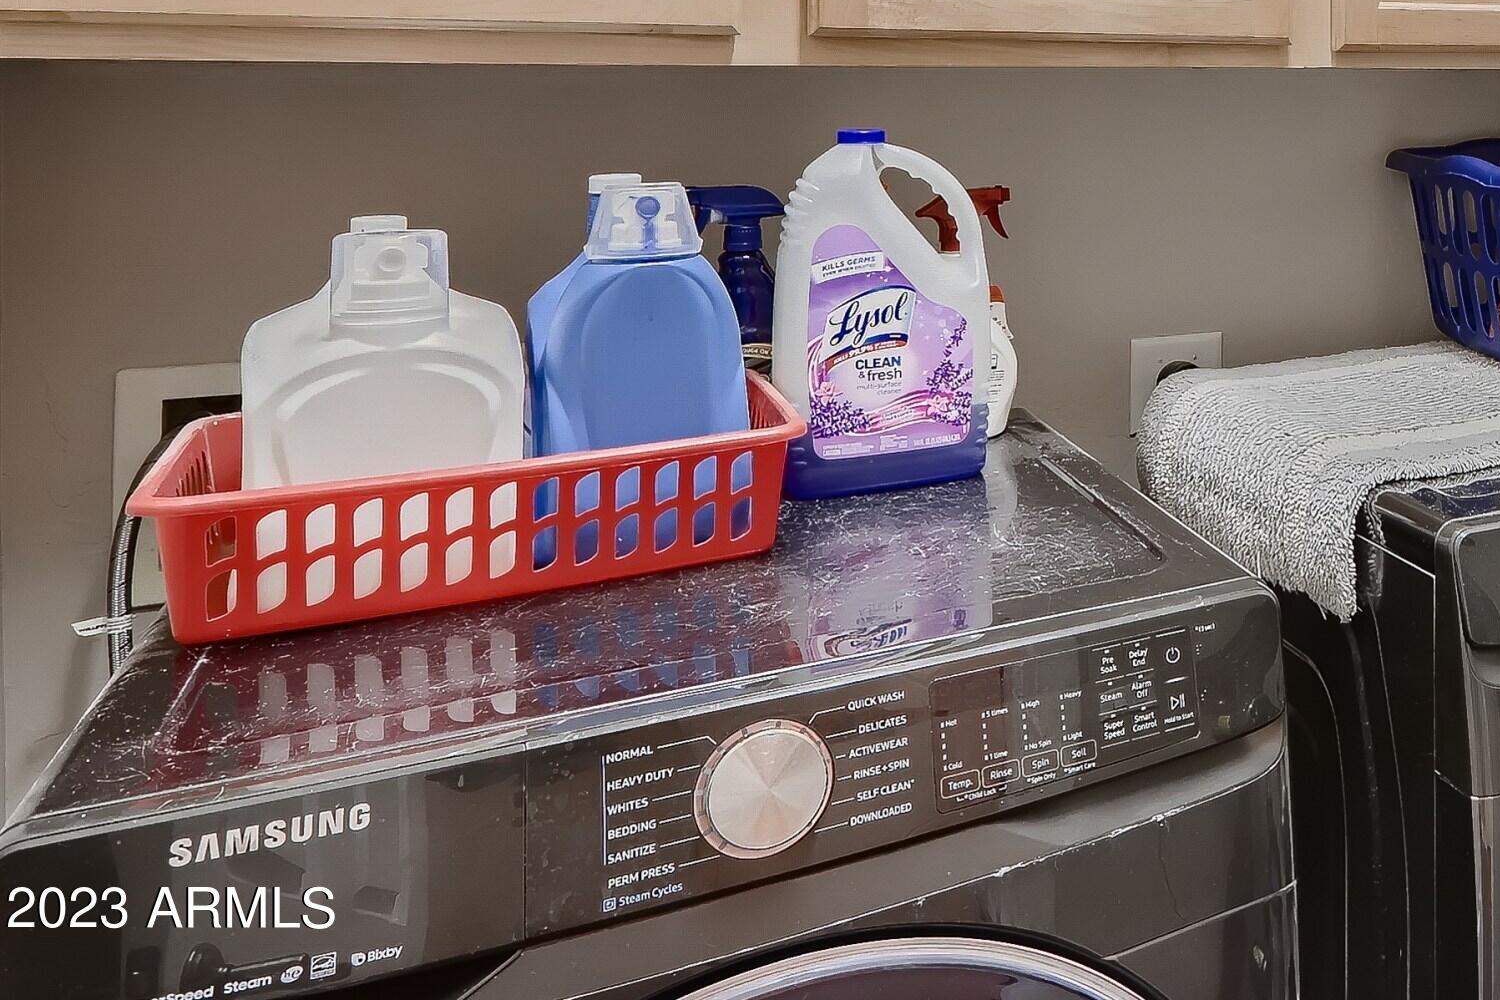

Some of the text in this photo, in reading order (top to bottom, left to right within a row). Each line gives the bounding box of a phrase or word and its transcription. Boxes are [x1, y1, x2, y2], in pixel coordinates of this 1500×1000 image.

[822, 256, 876, 272] KILLS GERMS
[829, 291, 908, 347] Lysol
[855, 356, 901, 370] CLEAN
[867, 367, 902, 381] fresh
[857, 382, 902, 390] multi-surface
[1102, 656, 1114, 665] Pre
[1128, 647, 1148, 660] Delay
[1100, 664, 1118, 674] Soak
[1132, 658, 1146, 667] End
[1131, 680, 1152, 691] Alarm
[1136, 688, 1148, 698] Off
[847, 690, 905, 711] QUICK WASH
[1100, 692, 1123, 704] Steam
[858, 714, 908, 735] DELICATES
[1134, 711, 1155, 724] Smart
[1103, 720, 1124, 732] Super
[1132, 718, 1158, 733] Control
[1067, 731, 1083, 741] Light
[1103, 728, 1126, 741] Speed
[606, 745, 654, 764] NORMAL
[848, 736, 909, 759] ACTIVEWEAR
[1071, 747, 1087, 759] Soil
[853, 758, 910, 780] RINSE+SPIN
[1031, 757, 1050, 770] Spin
[606, 767, 674, 792] HEAVY DUTY
[990, 767, 1013, 780] Rinse
[948, 777, 973, 790] Temp.
[857, 787, 880, 802] SELF
[607, 797, 649, 816] WHITES
[850, 802, 912, 827] DOWNLOADED
[169, 802, 372, 868] SAMSUNG
[607, 819, 657, 840] BEDDING
[607, 843, 657, 865] SANITIZE
[608, 863, 675, 889] PERM PRESS
[618, 882, 684, 907] Steam Cycles
[366, 945, 403, 964] Bixby
[223, 973, 273, 995] Steam
